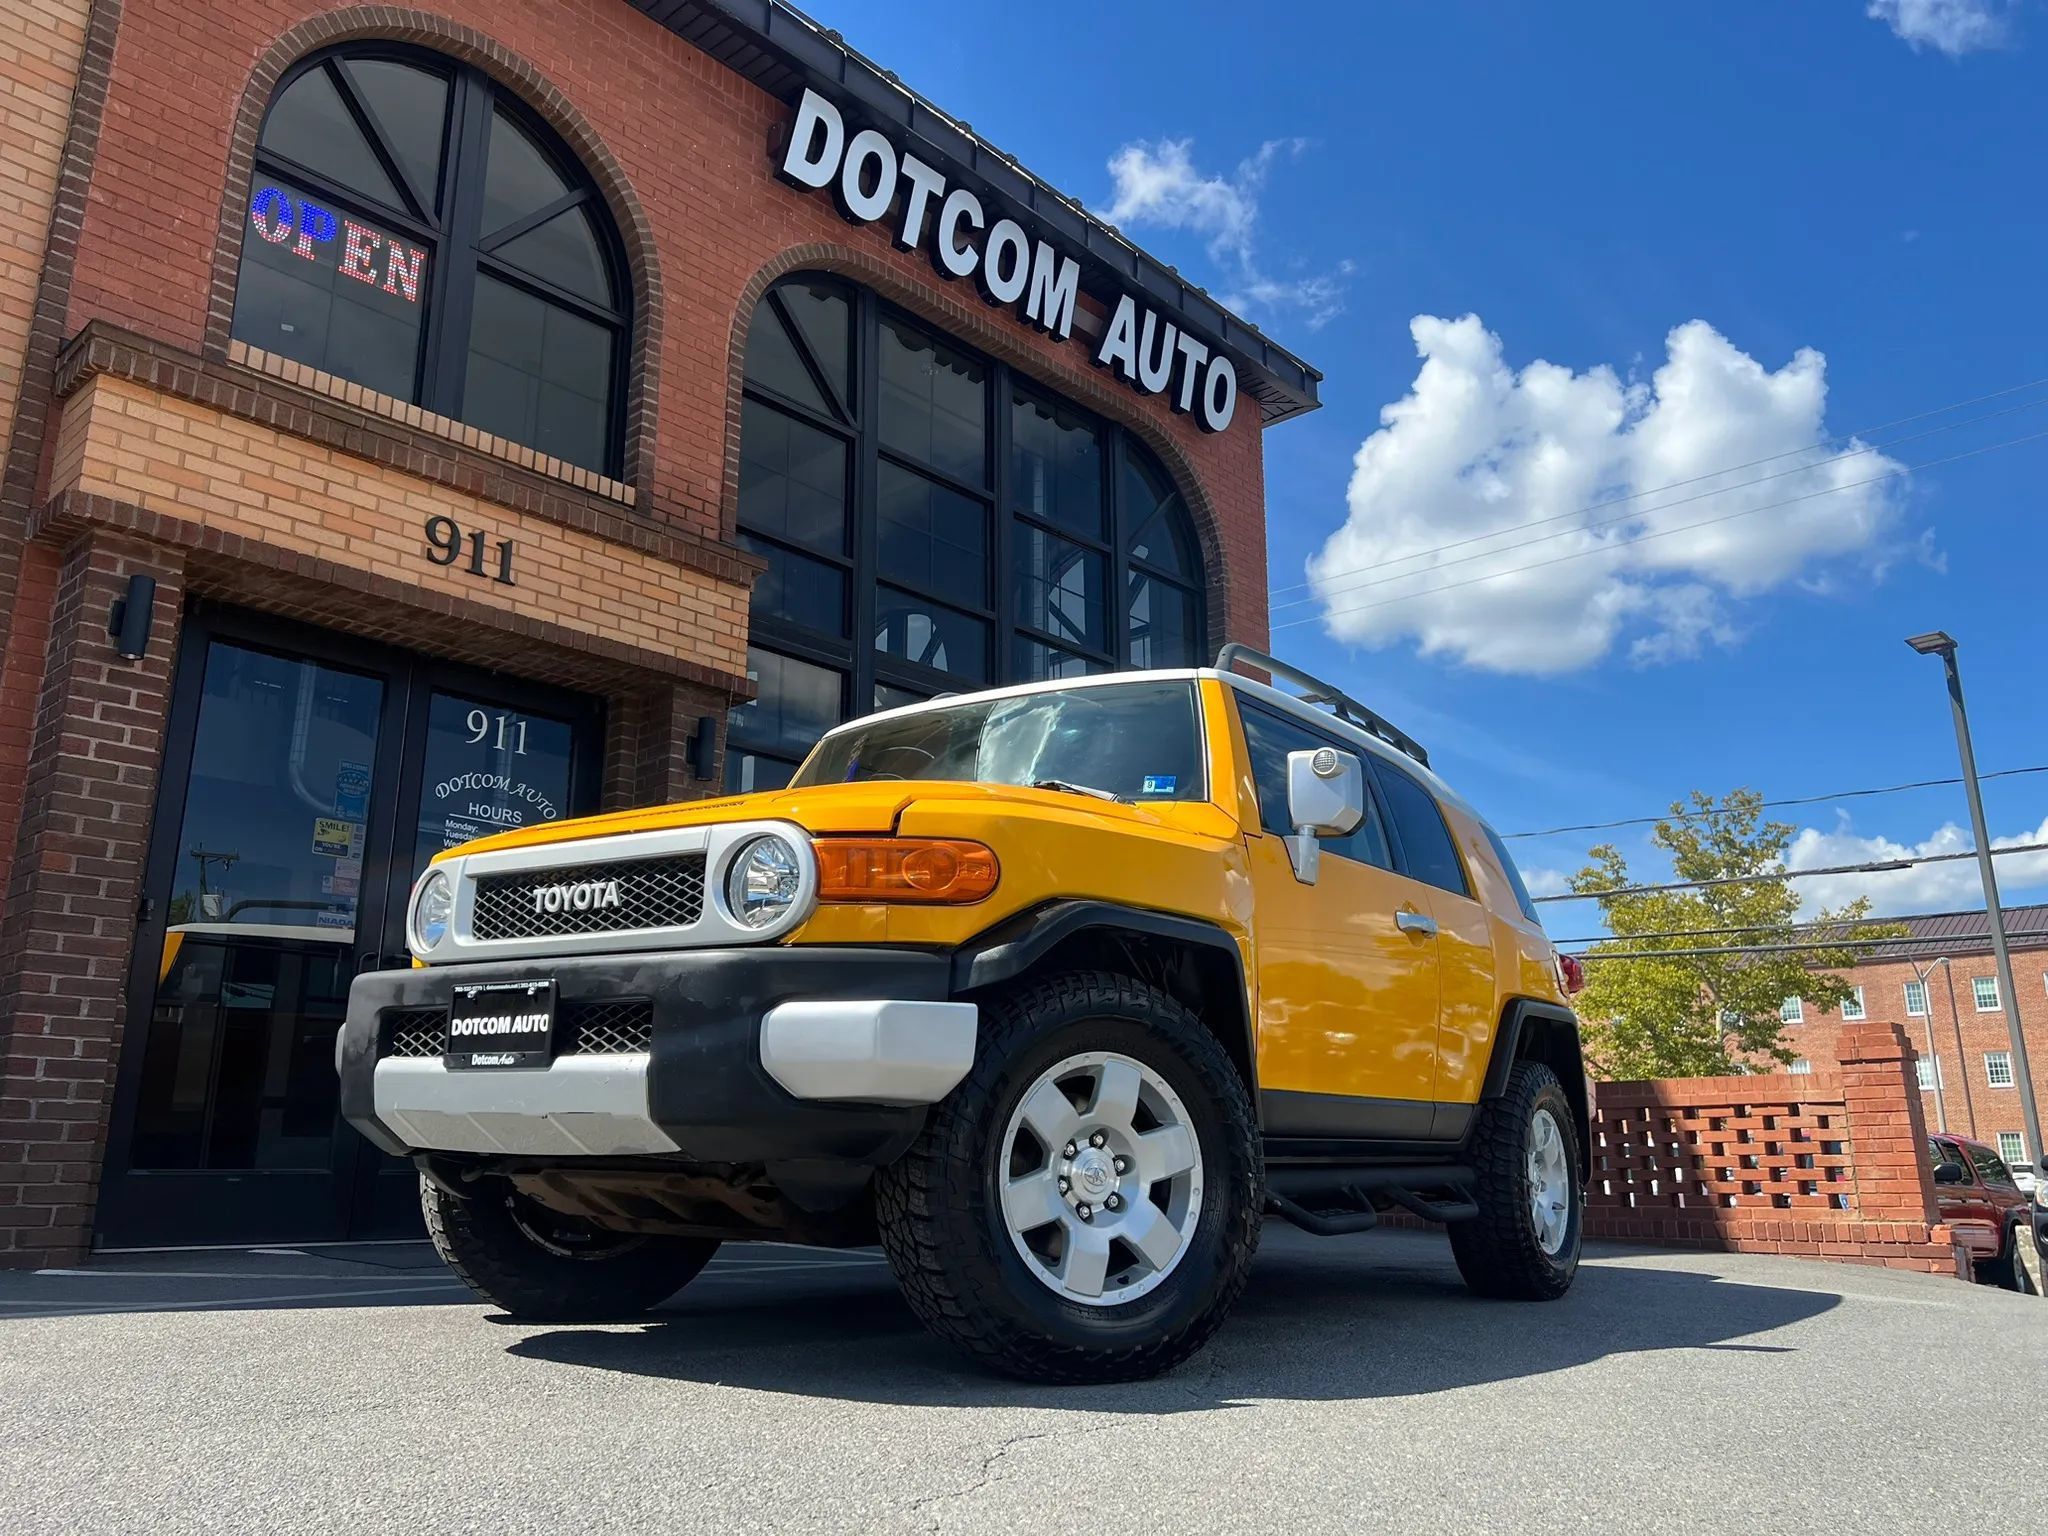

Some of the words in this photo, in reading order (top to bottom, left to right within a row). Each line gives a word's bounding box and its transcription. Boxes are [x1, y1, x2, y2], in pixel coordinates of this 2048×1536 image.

[252, 186, 425, 302] OPEN
[783, 88, 1080, 339] DOTCOM
[1098, 294, 1238, 433] AUTO
[425, 515, 516, 587] 911
[465, 709, 527, 755] 911
[435, 772, 510, 799] DOTCOM
[509, 783, 557, 820] AUTO
[1147, 780, 1153, 789] 9
[468, 802, 523, 824] HOURS
[318, 820, 350, 833] SMILE!
[445, 819, 479, 834] Monday:
[533, 881, 620, 914] TOYOTA
[318, 916, 354, 927] NIADA
[451, 1016, 511, 1036] DOTCOM
[511, 1013, 549, 1033] AUTO
[471, 1053, 499, 1066] Dotcom
[498, 1053, 515, 1065] Auto
